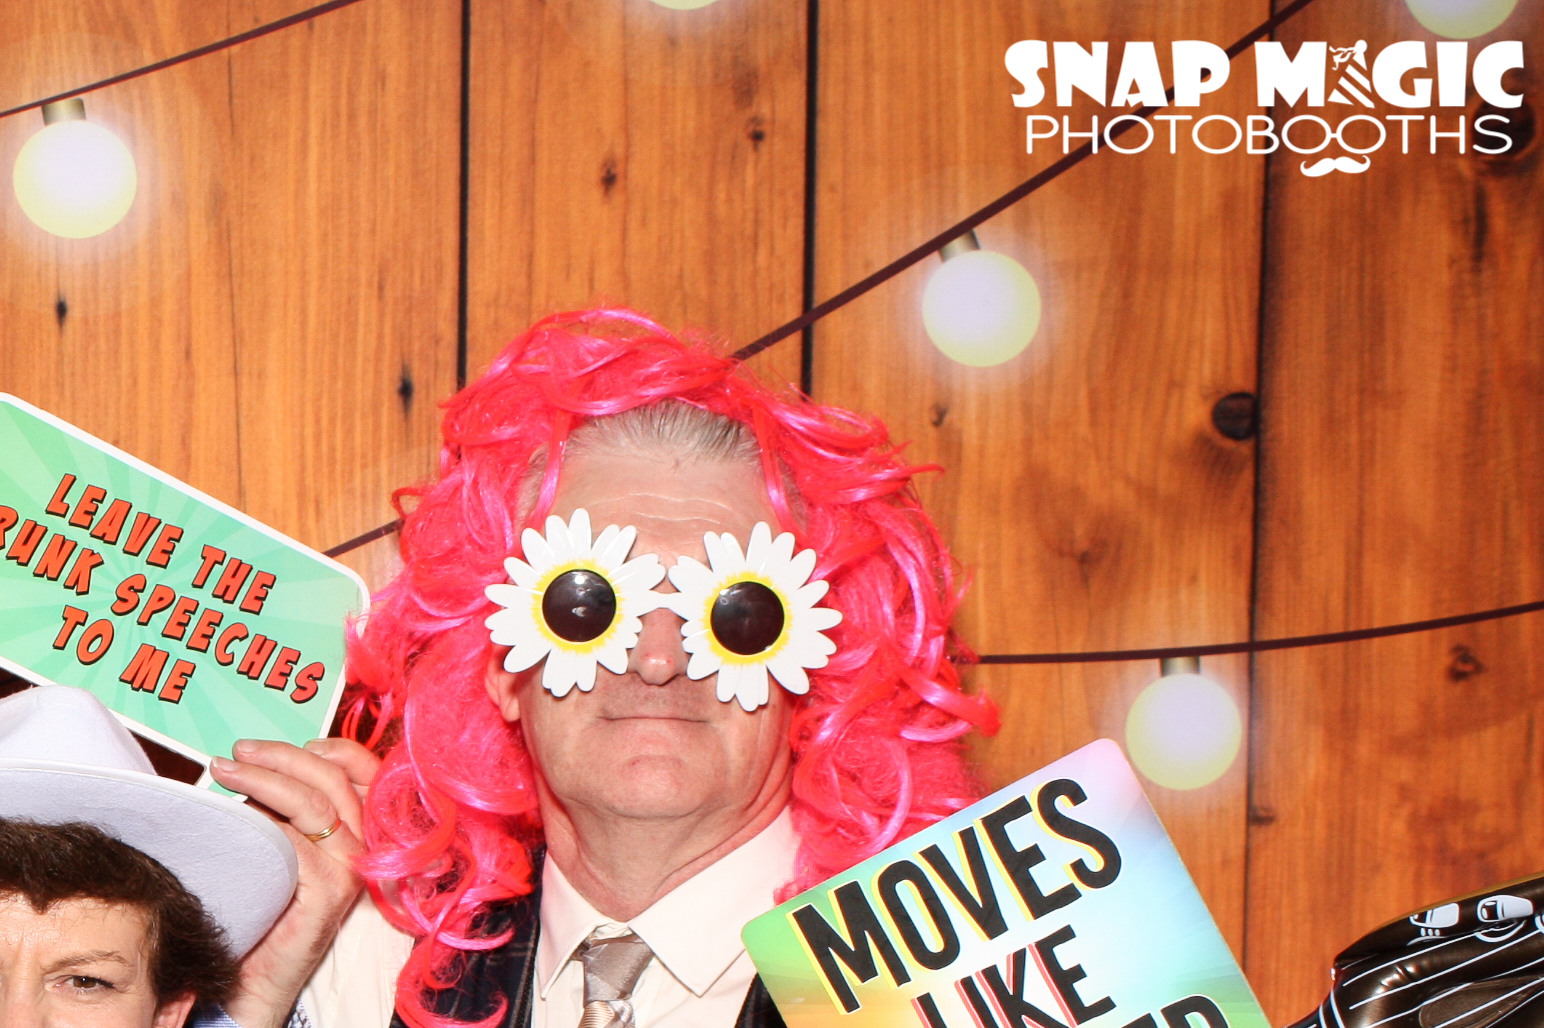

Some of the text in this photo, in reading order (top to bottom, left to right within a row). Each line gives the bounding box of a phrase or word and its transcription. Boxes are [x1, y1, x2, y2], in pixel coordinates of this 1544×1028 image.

[46, 473, 277, 616] LEAVE THE
[53, 605, 196, 705] TO ME
[111, 573, 326, 705] SPEECHES
[787, 778, 1123, 1015] MOVES
